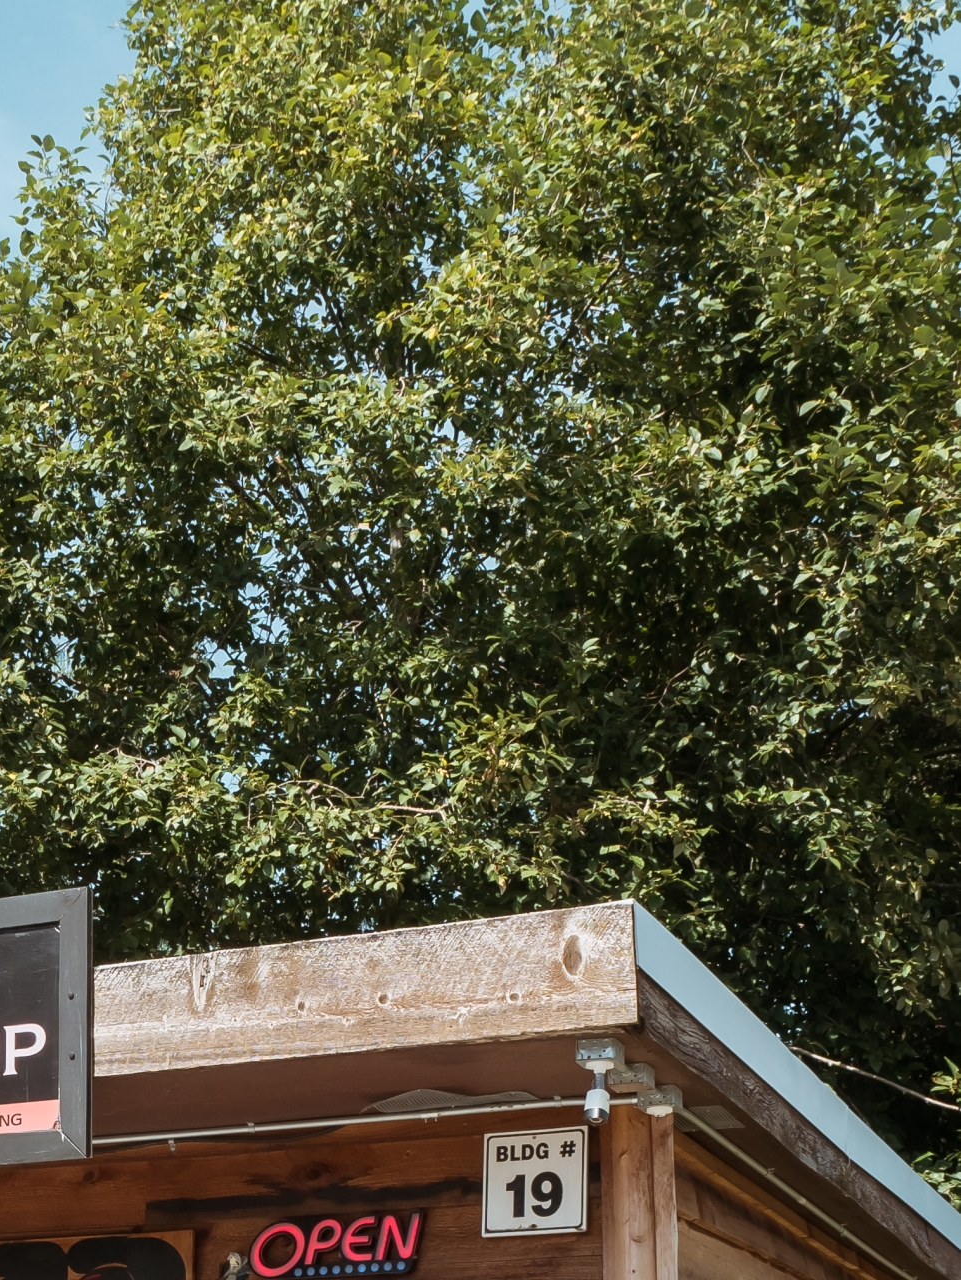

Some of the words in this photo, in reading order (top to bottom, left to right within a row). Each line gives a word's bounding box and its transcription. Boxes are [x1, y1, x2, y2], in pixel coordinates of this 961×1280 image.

[495, 1142, 550, 1163] BLDG
[558, 1139, 577, 1159] #
[505, 1170, 564, 1219] 19
[249, 1212, 421, 1278] OPEN
